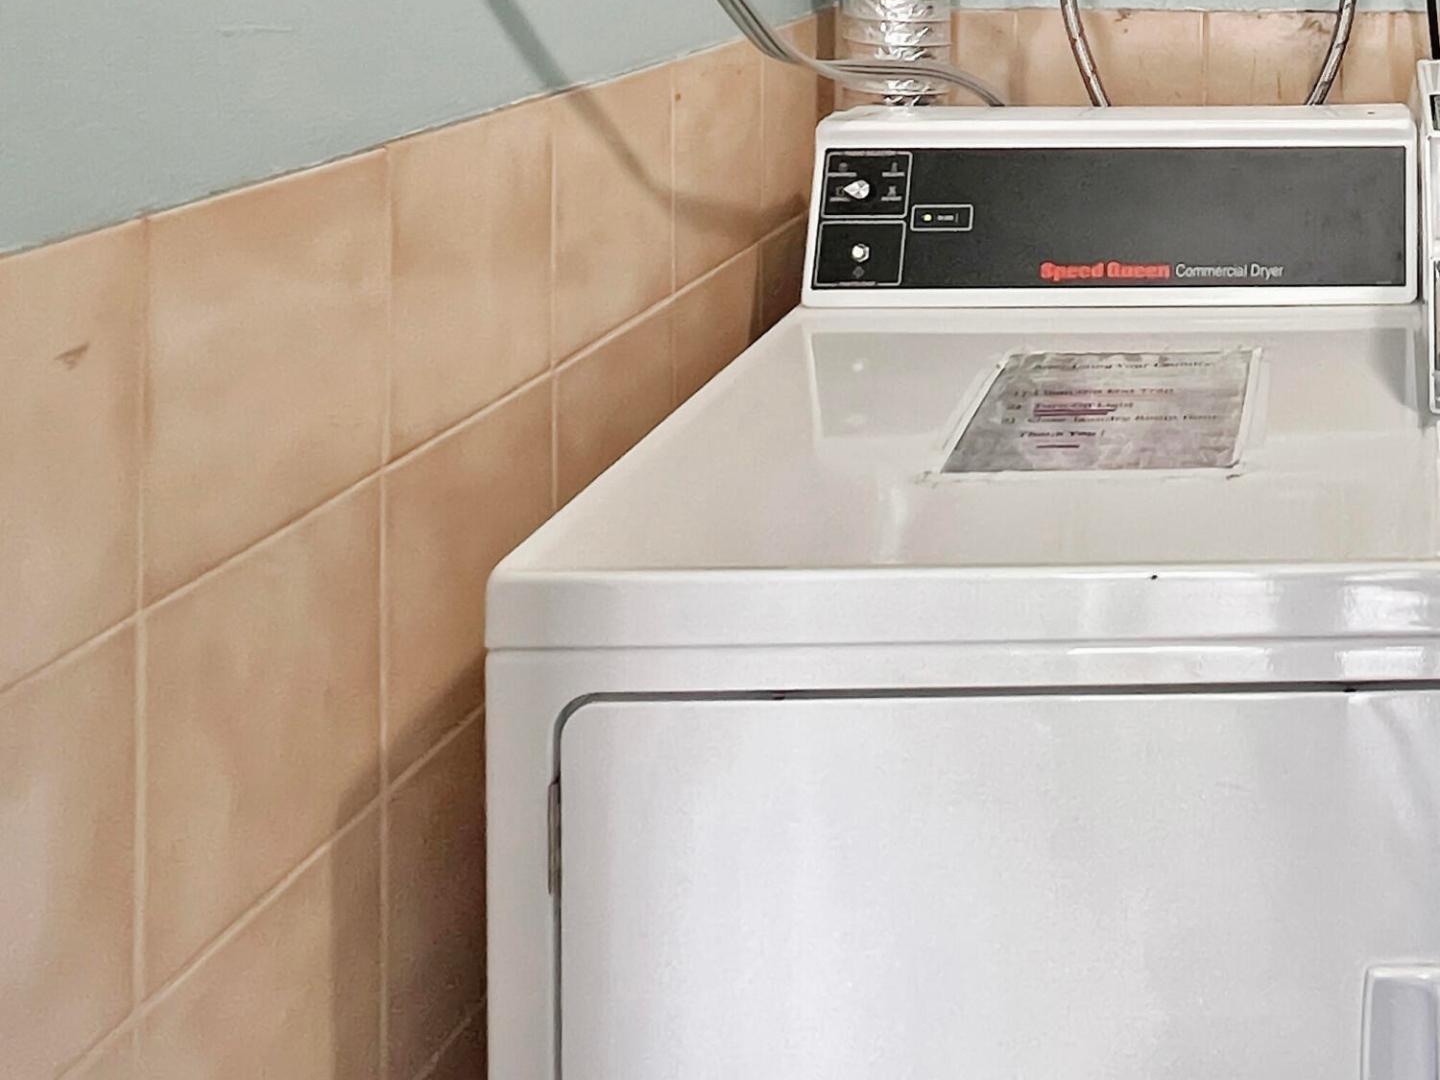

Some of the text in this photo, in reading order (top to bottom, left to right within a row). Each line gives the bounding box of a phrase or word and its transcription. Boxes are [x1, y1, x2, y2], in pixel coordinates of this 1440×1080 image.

[1040, 261, 1284, 281] Speed Queen Commercial Dryer
